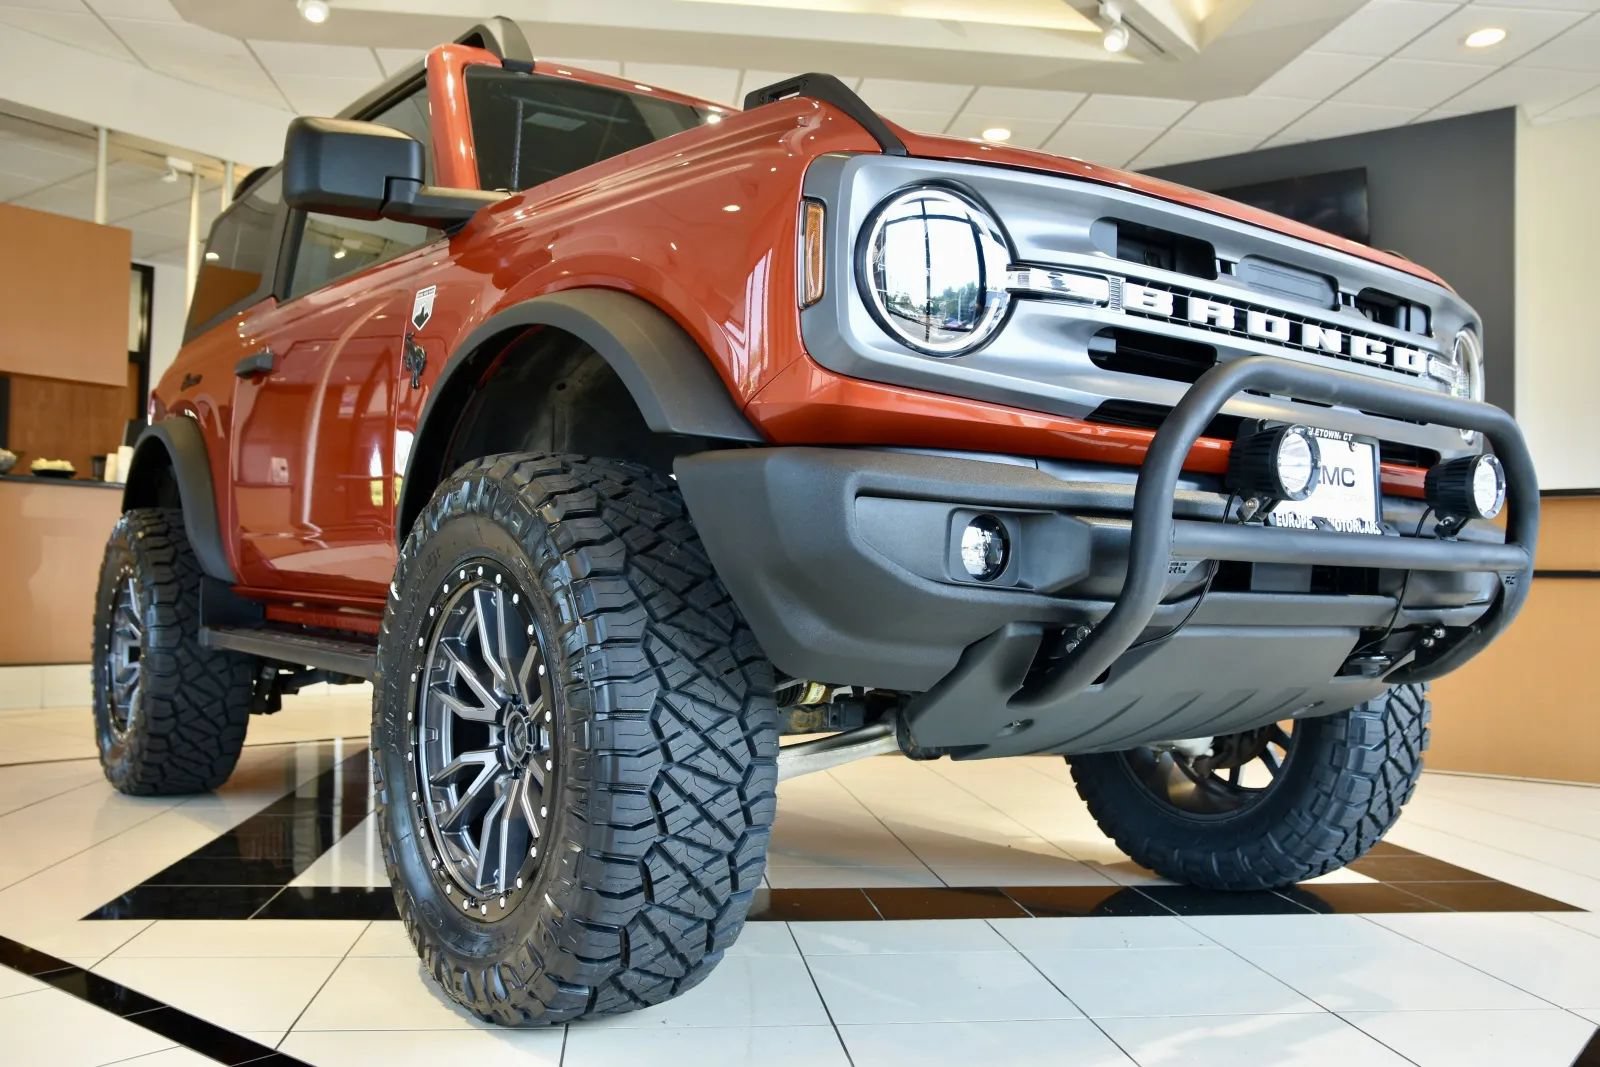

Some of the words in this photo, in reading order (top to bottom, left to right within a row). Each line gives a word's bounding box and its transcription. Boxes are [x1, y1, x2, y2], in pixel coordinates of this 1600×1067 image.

[1122, 282, 1427, 374] BRONCO
[1343, 433, 1353, 441] CT
[1318, 465, 1355, 487] MC
